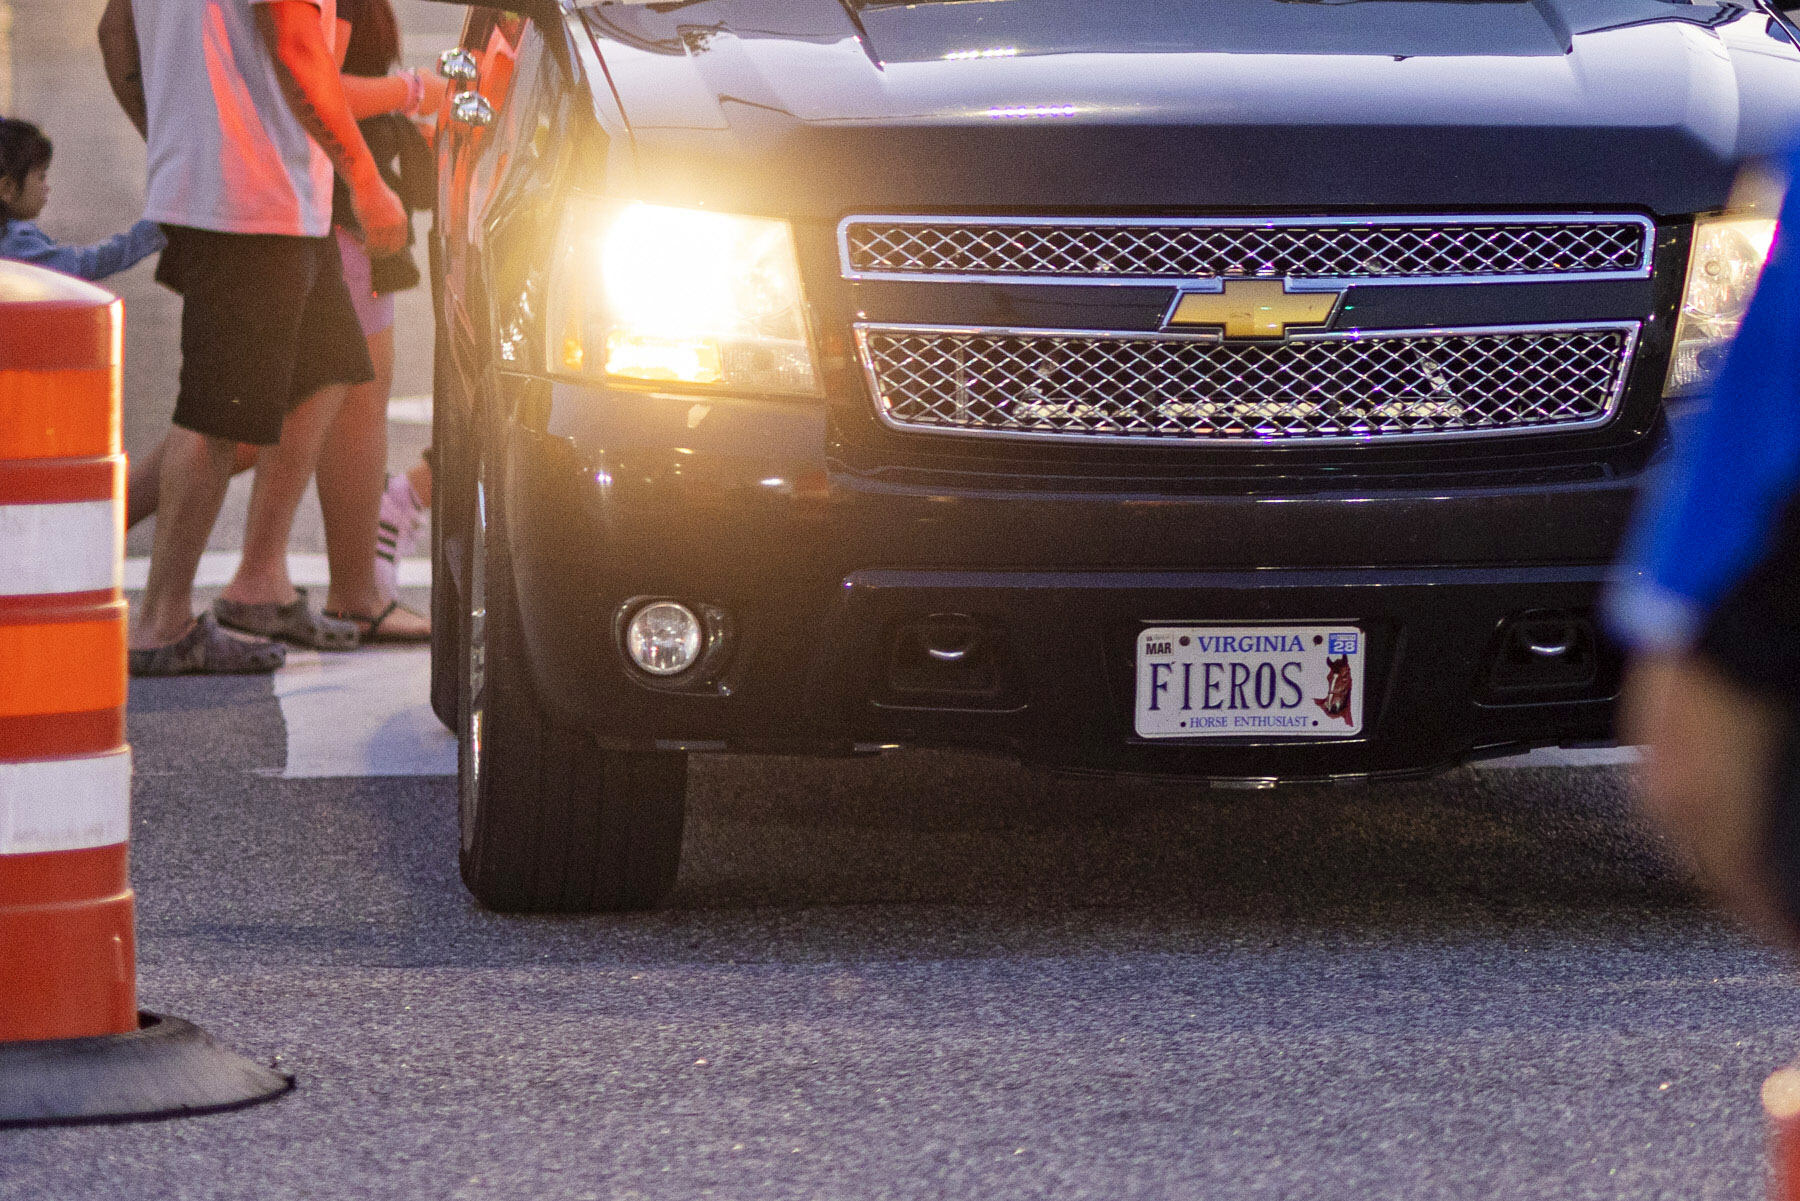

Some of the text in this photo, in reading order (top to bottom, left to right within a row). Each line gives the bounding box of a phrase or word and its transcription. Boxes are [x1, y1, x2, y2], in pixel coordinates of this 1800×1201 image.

[1146, 642, 1171, 655] MAR
[1198, 635, 1305, 653] VIRGINIA
[1334, 641, 1355, 652] 28
[1148, 661, 1303, 711] FIEROS
[1190, 716, 1308, 728] HORSE ENTHUSIAST
